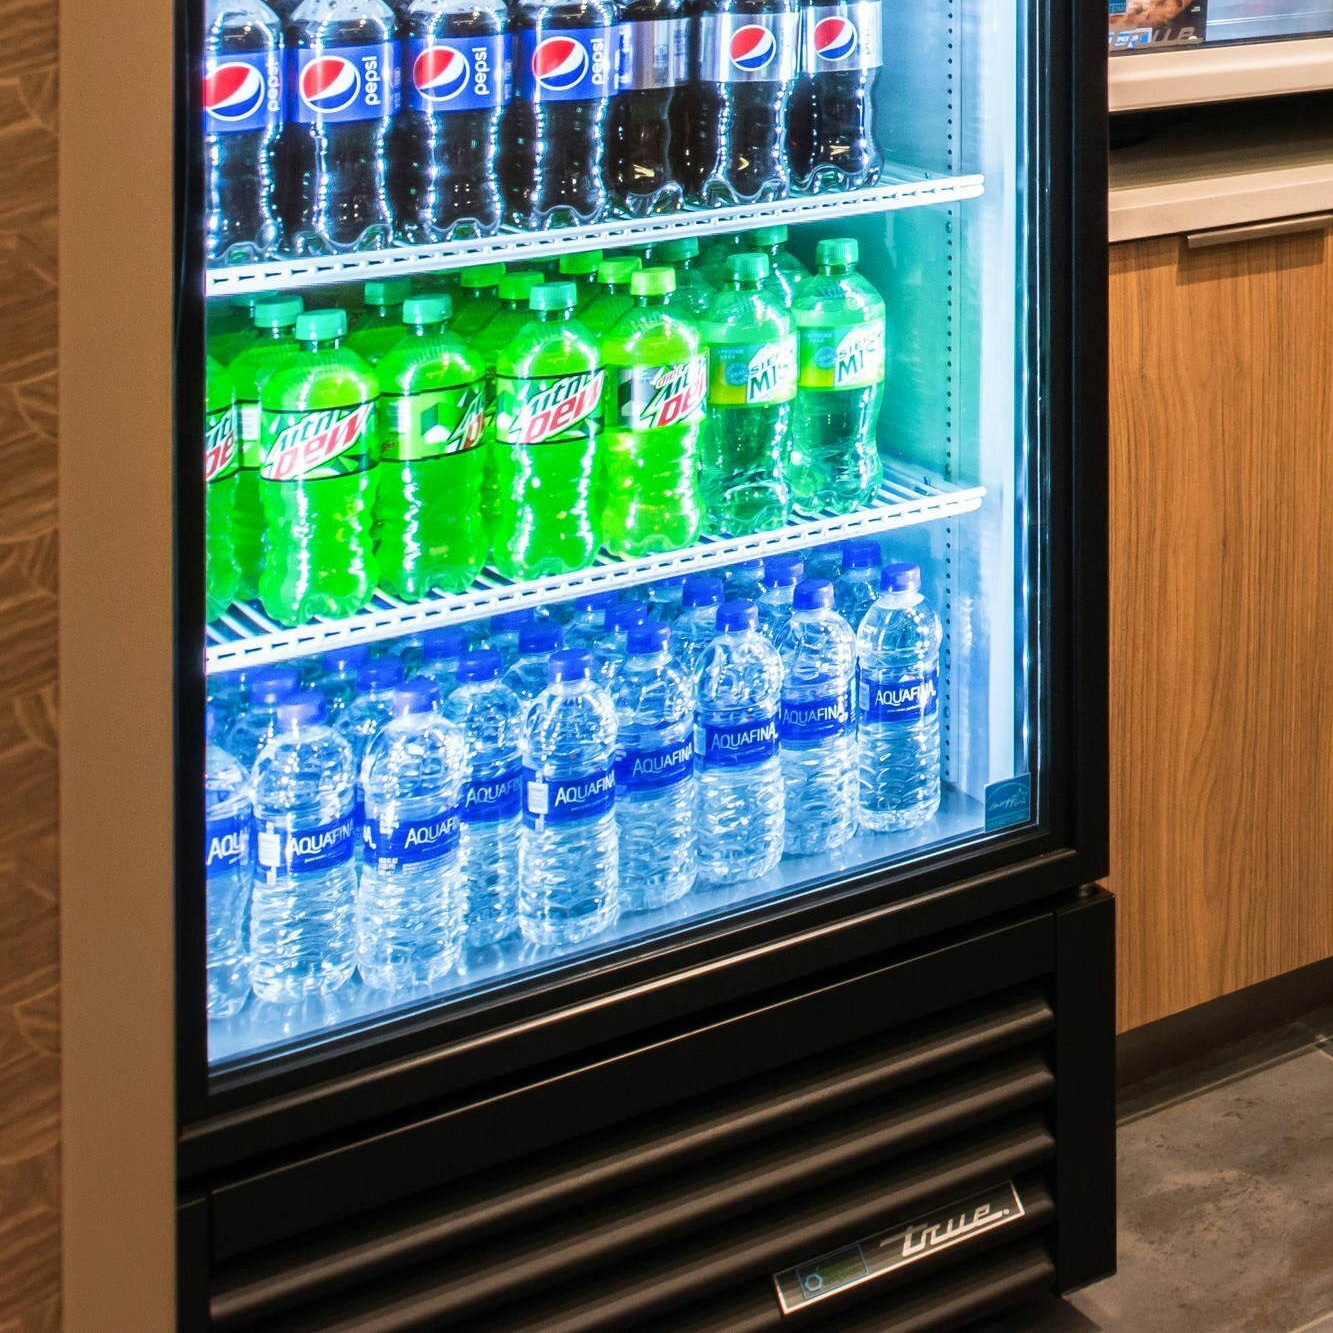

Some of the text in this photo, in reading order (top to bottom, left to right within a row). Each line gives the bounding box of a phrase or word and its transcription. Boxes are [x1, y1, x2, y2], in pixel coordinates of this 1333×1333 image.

[362, 56, 380, 106] pepsi
[473, 47, 489, 96] pepsi
[875, 678, 936, 706] AQUAFINA
[783, 702, 849, 726] AQUAFINA
[712, 722, 778, 750] AQUAFINA
[881, 1204, 1009, 1257] true
